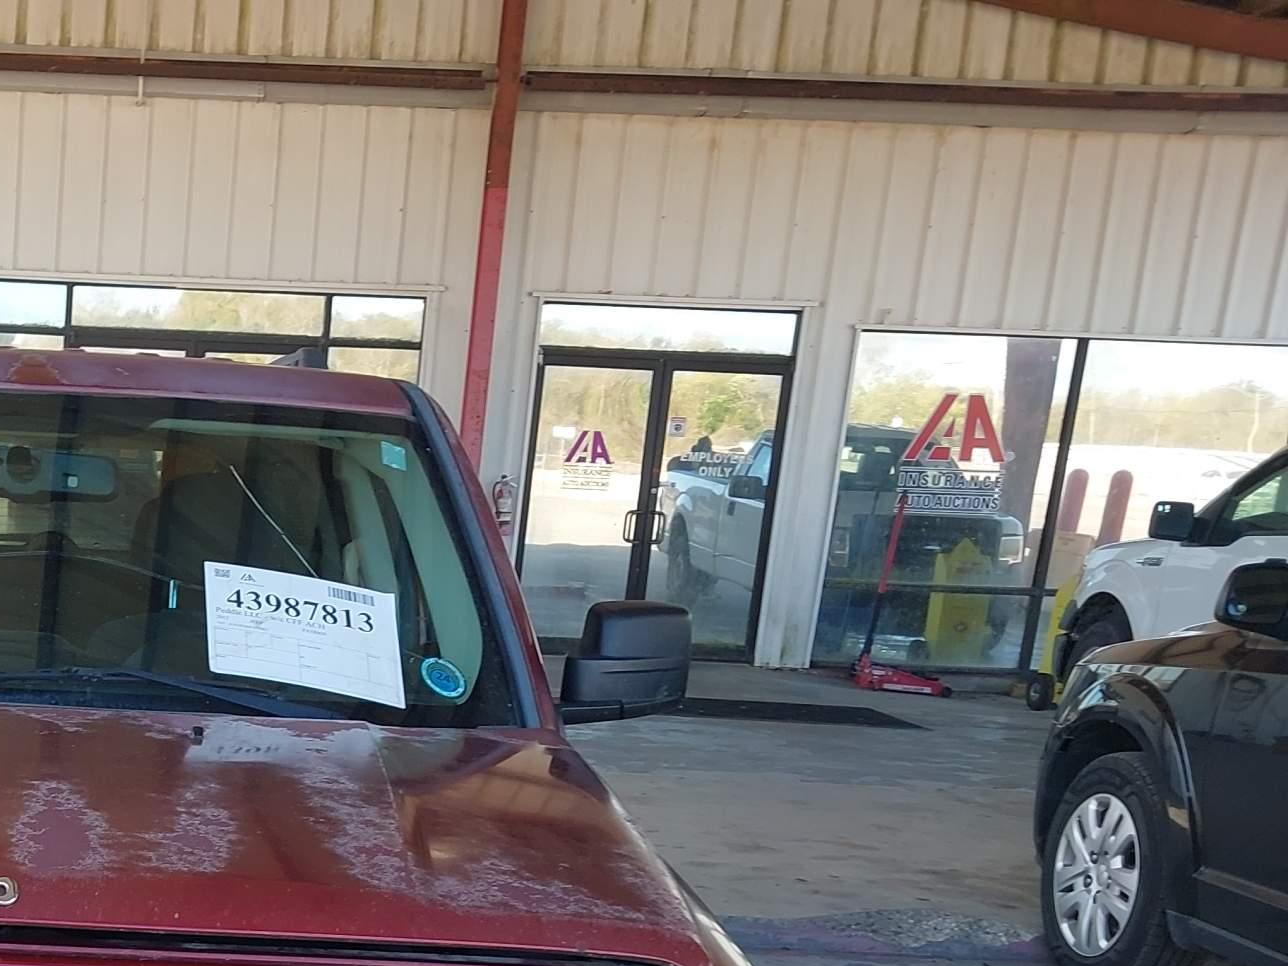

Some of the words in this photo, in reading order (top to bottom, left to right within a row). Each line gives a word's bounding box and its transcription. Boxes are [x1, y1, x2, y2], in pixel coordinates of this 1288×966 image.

[679, 452, 754, 465] EMPLOYEES
[698, 466, 733, 477] ONLY
[897, 472, 1002, 489] INSURANCE
[932, 495, 1000, 510] AUCTIONS
[226, 588, 374, 633] 43987813
